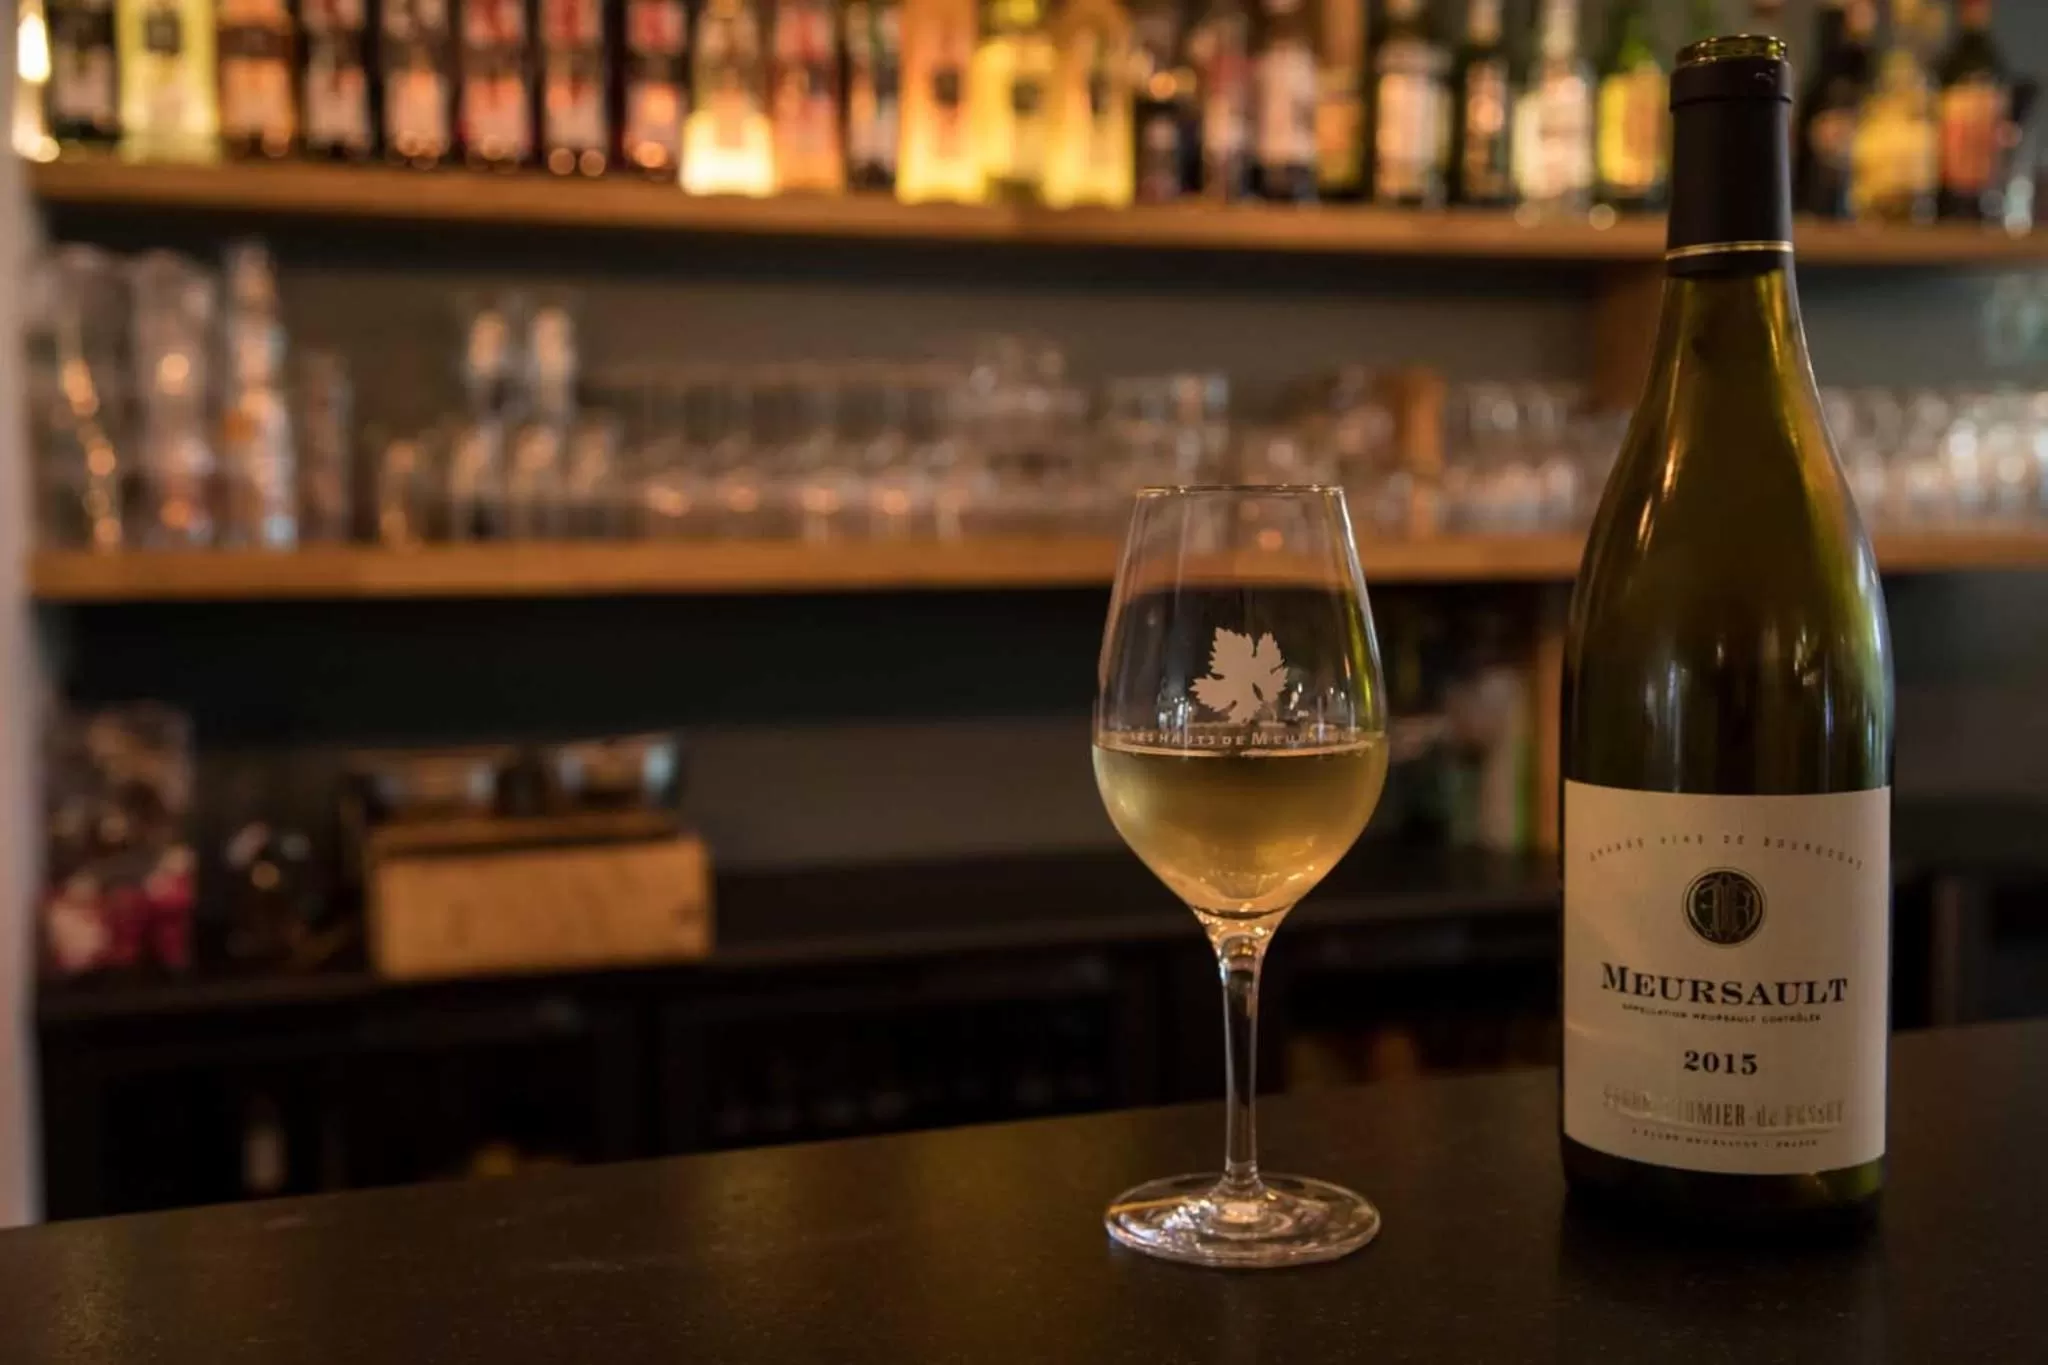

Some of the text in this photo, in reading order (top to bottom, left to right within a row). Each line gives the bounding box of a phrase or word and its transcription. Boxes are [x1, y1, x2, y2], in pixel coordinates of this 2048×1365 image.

[1222, 736, 1245, 746] DE
[1601, 962, 1848, 1006] MEURSAULT
[1683, 1050, 1759, 1076] 2015
